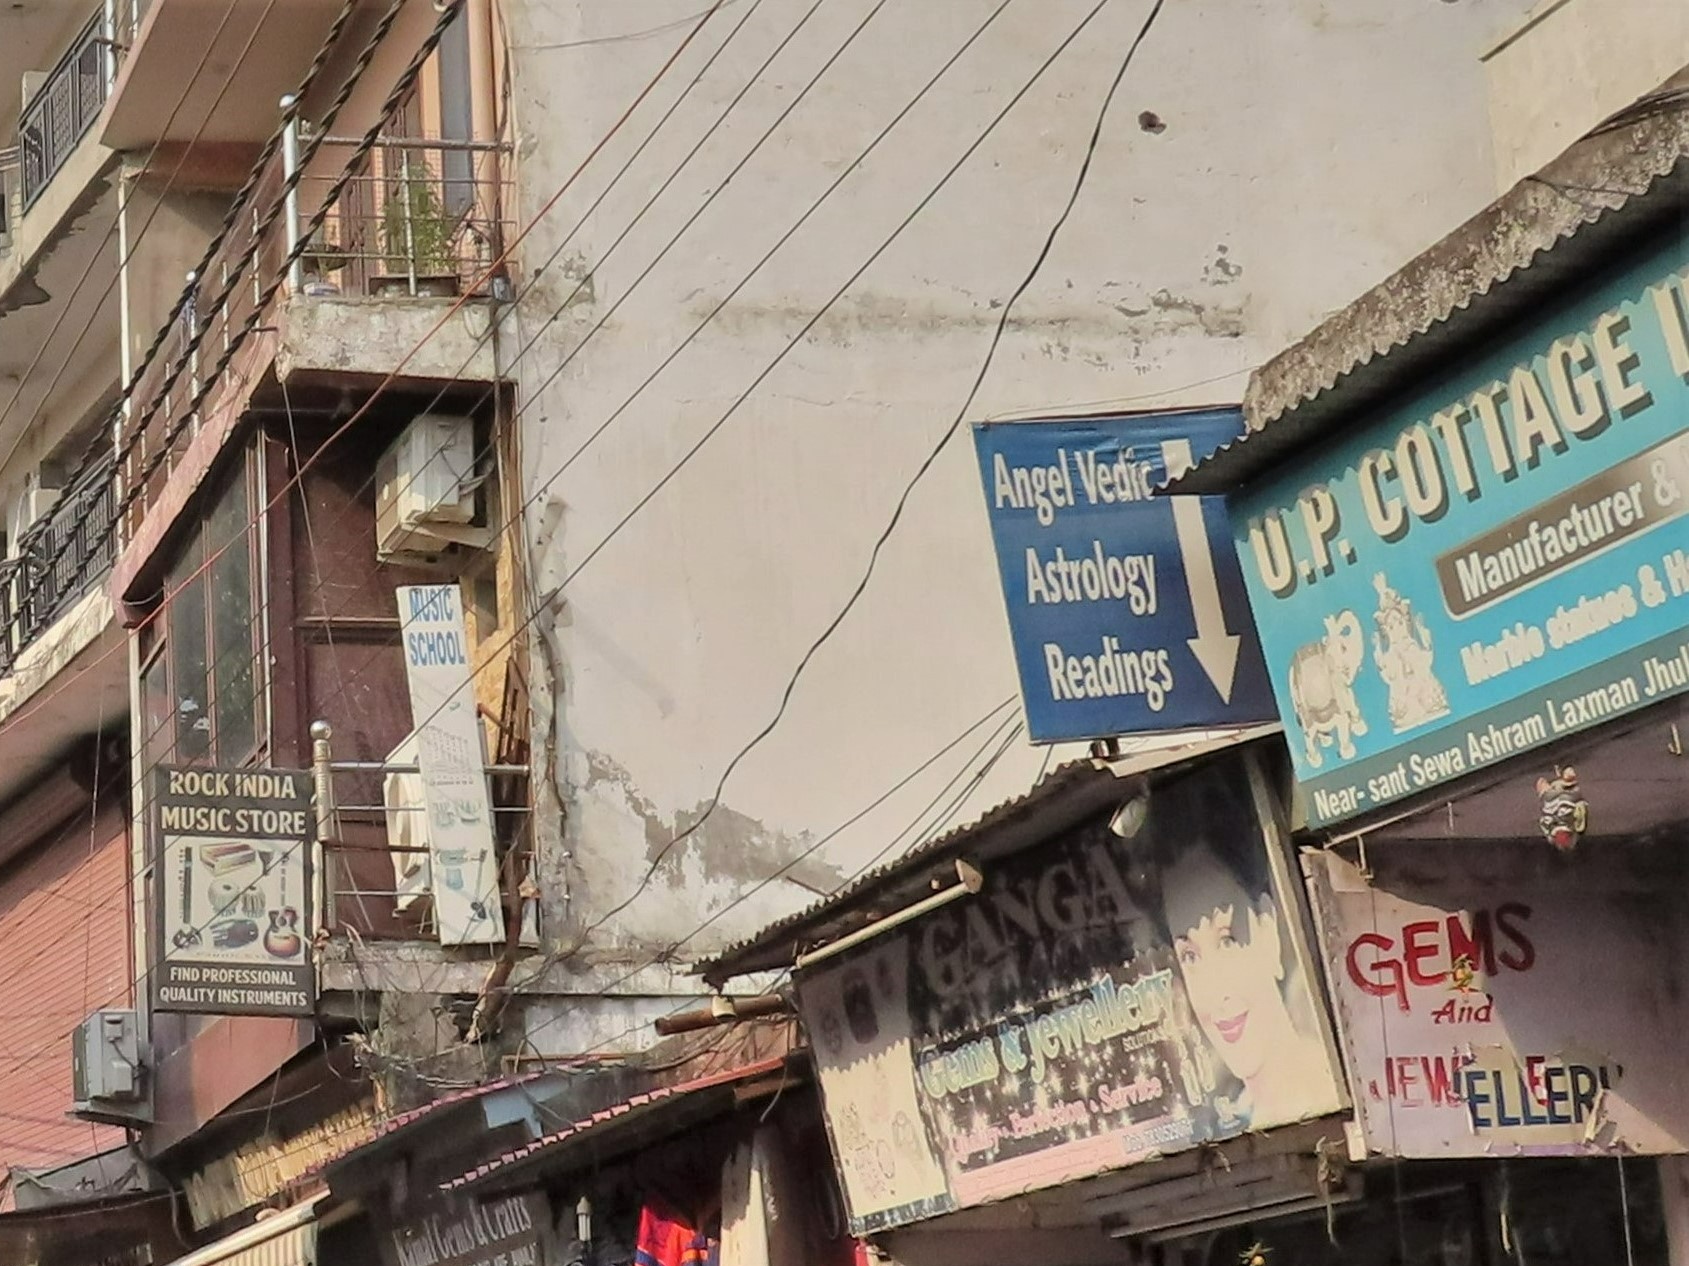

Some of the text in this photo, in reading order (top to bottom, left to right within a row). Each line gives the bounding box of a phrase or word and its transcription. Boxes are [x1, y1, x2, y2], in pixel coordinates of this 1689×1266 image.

[1250, 482, 1354, 596] U.P.
[1359, 311, 1652, 538] COTTAGE
[993, 447, 1156, 525] Angel Vedic
[1455, 459, 1681, 602] Manufacturer &
[1025, 539, 1158, 615] Astrology
[1638, 564, 1667, 608] &
[407, 588, 454, 623] MUSIC
[409, 631, 465, 667] SCHOOL
[1043, 642, 1174, 711] Readings
[1313, 640, 1689, 822] Near- sant Sewa Ashram Laxman Jhul
[169, 772, 297, 799] ROCK INDIA
[161, 806, 306, 834] MUSIC STORE
[922, 843, 1146, 996] GANGA
[169, 967, 297, 987] FIND PROFESSIONAL
[1345, 902, 1536, 1014] GEMS
[159, 985, 308, 1007] QUALITY INSTRUMENTS
[1432, 993, 1495, 1025] And
[919, 1036, 1001, 1099] Gems
[998, 1020, 1027, 1072] &
[1097, 1075, 1163, 1114] Service
[481, 1196, 532, 1241] Crafts
